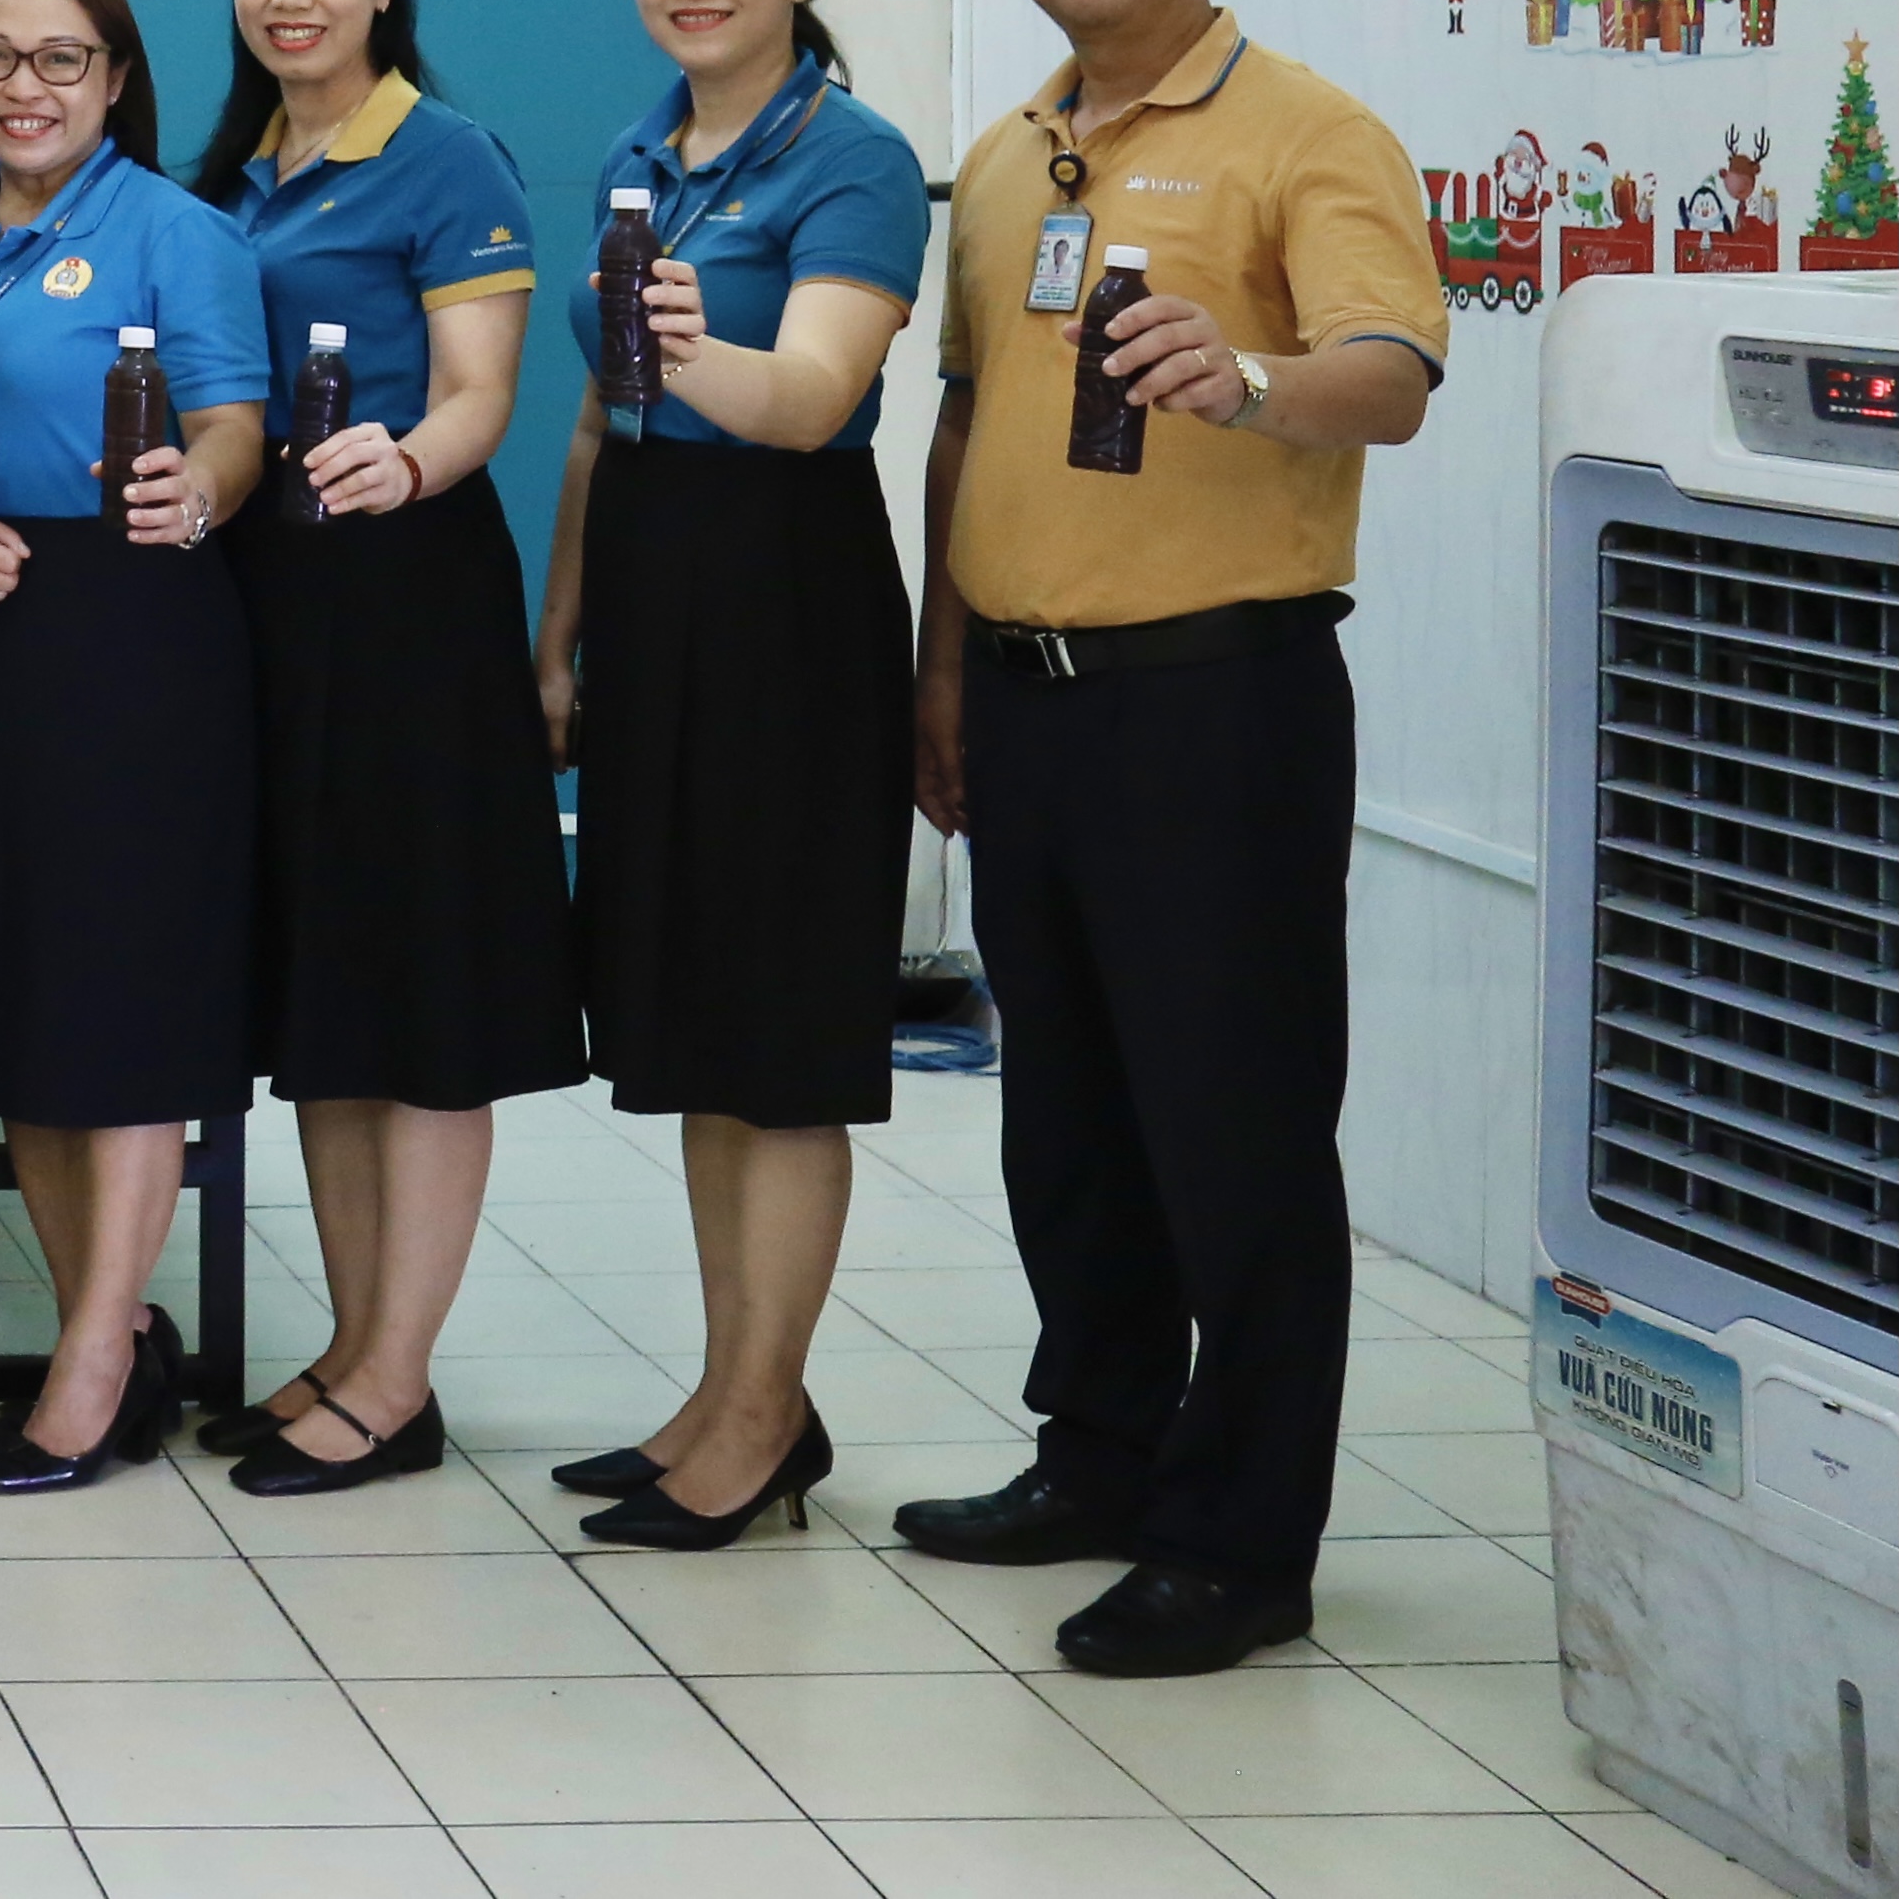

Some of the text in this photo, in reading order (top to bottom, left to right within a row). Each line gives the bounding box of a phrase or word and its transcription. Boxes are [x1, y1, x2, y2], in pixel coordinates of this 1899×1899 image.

[1733, 349, 1794, 366] SUNHOUSE
[1604, 1370, 1644, 1422] CỨU
[1652, 1392, 1713, 1454] NÓNG
